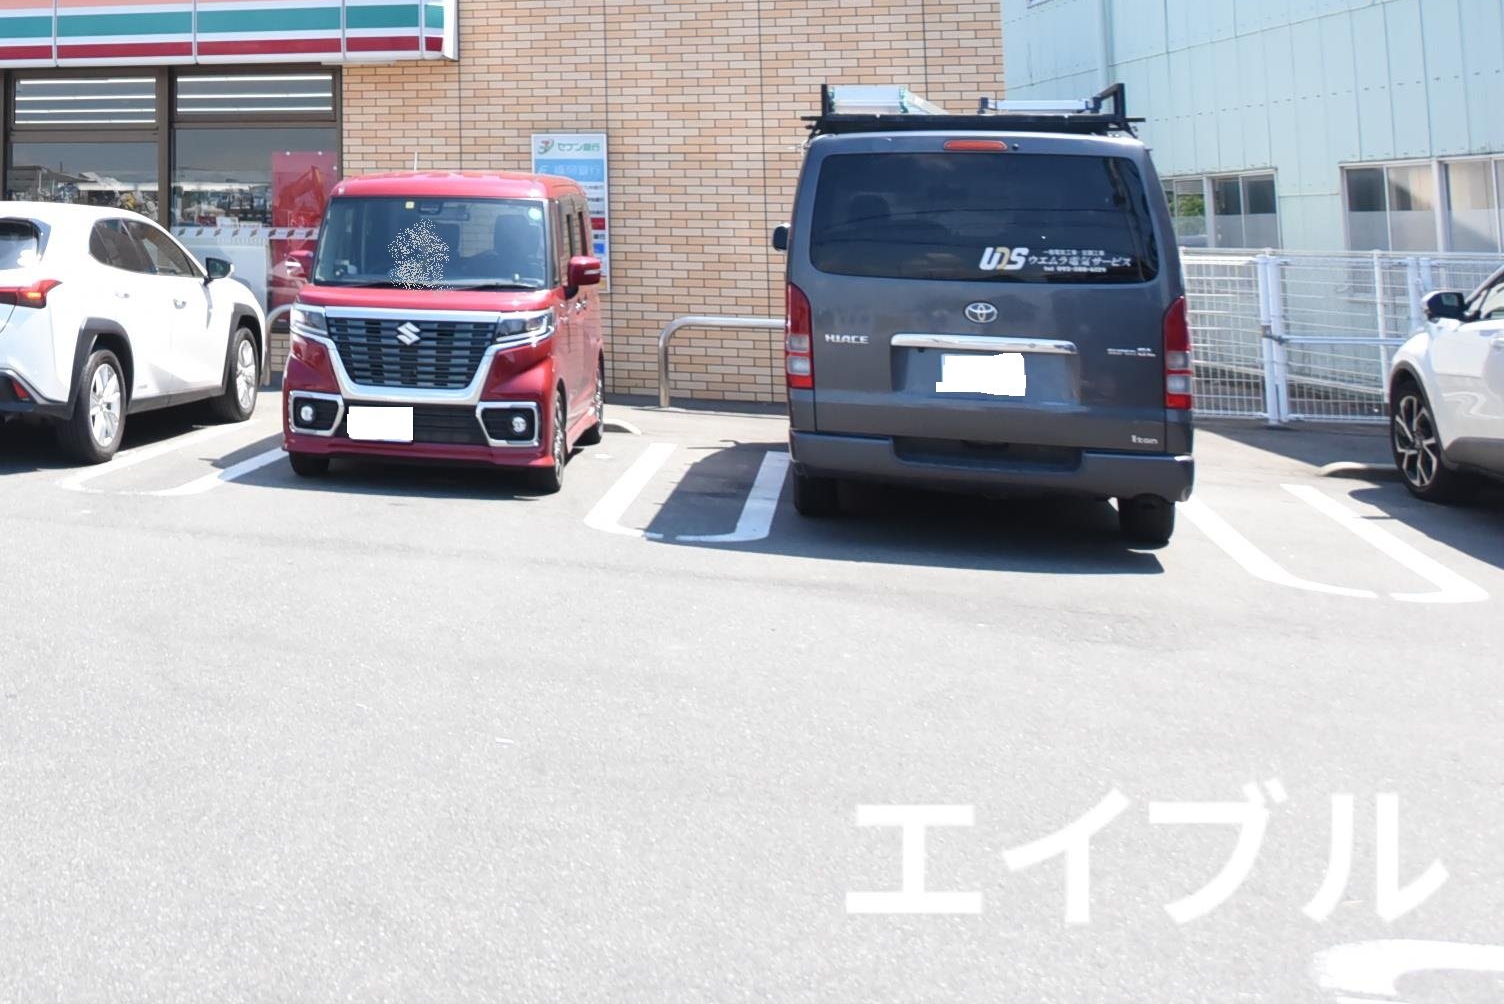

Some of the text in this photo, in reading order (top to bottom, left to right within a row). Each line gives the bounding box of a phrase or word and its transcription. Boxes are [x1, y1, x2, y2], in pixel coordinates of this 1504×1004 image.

[557, 142, 601, 152] セブン銀行
[824, 333, 870, 345] HIACE
